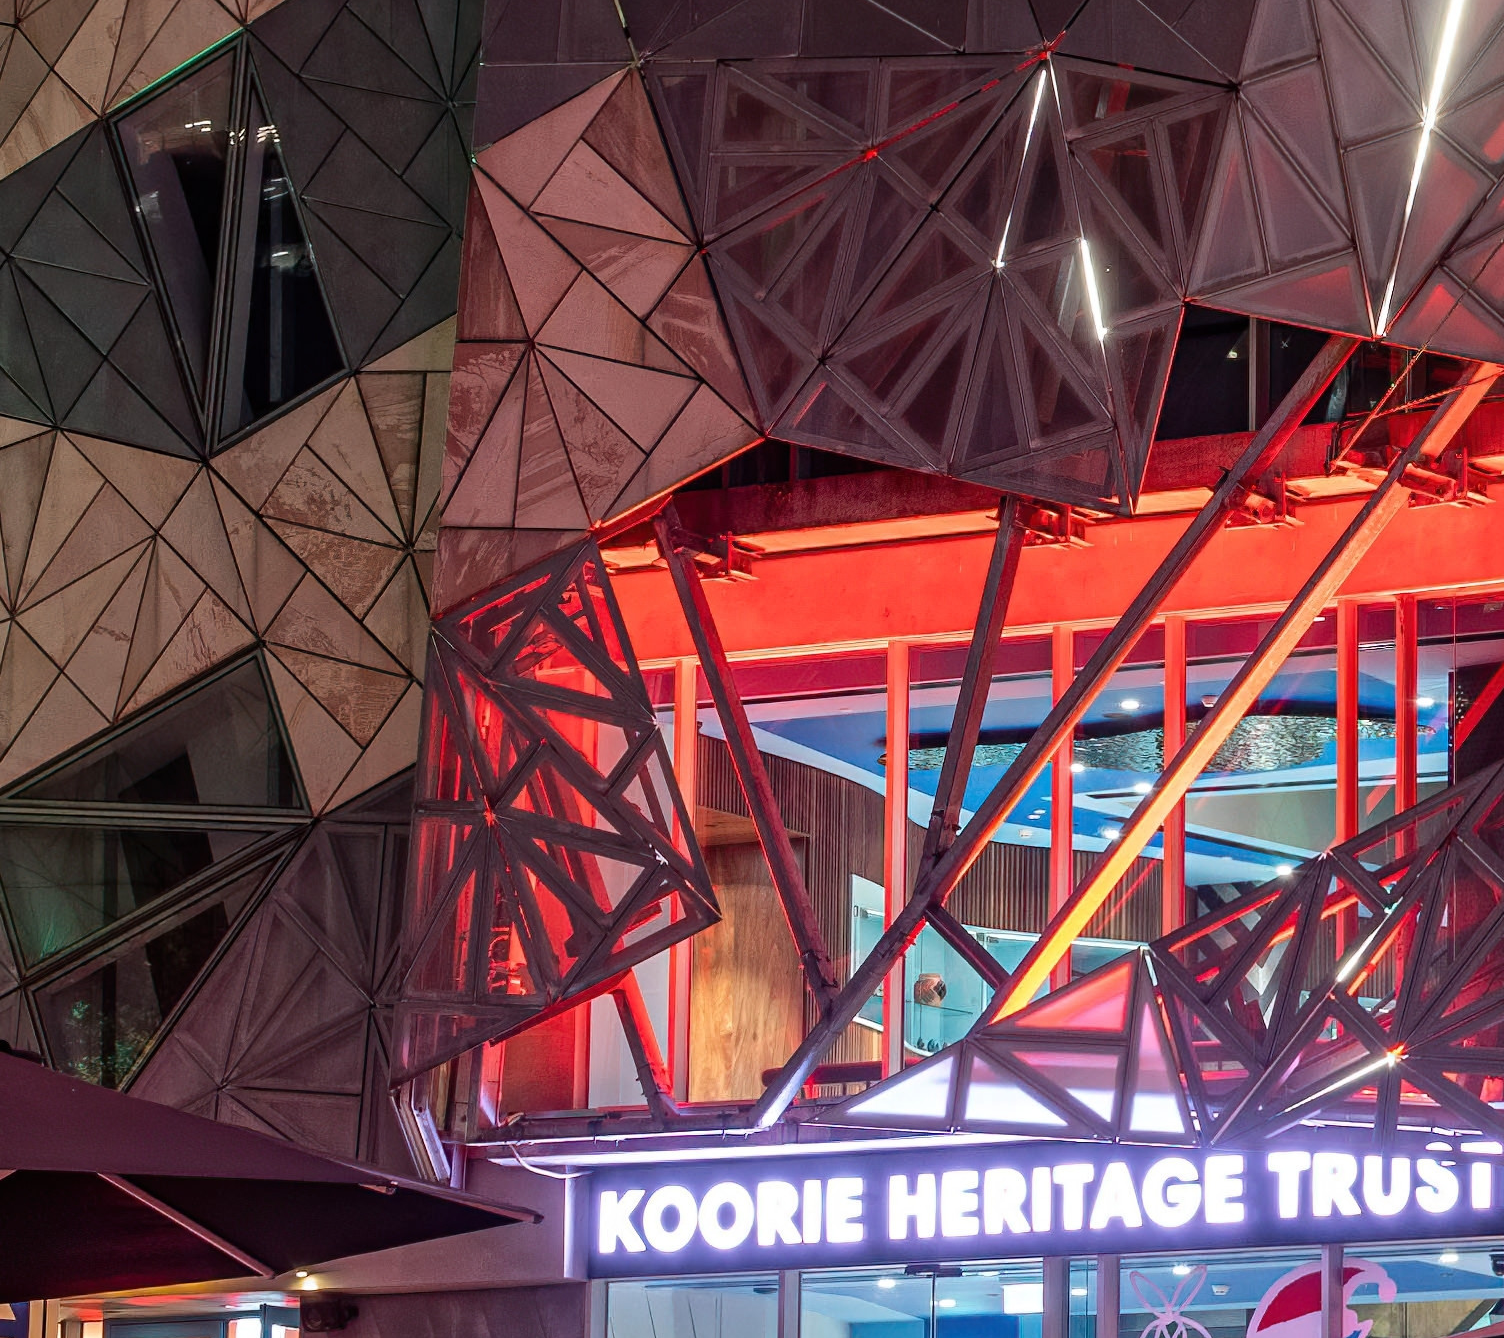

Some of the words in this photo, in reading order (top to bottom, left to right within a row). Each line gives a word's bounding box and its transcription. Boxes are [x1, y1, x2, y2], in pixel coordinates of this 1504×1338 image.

[598, 1177, 864, 1254] KOORIE
[887, 1155, 1245, 1242] HERITAGE
[1267, 1142, 1503, 1218] TRUST
